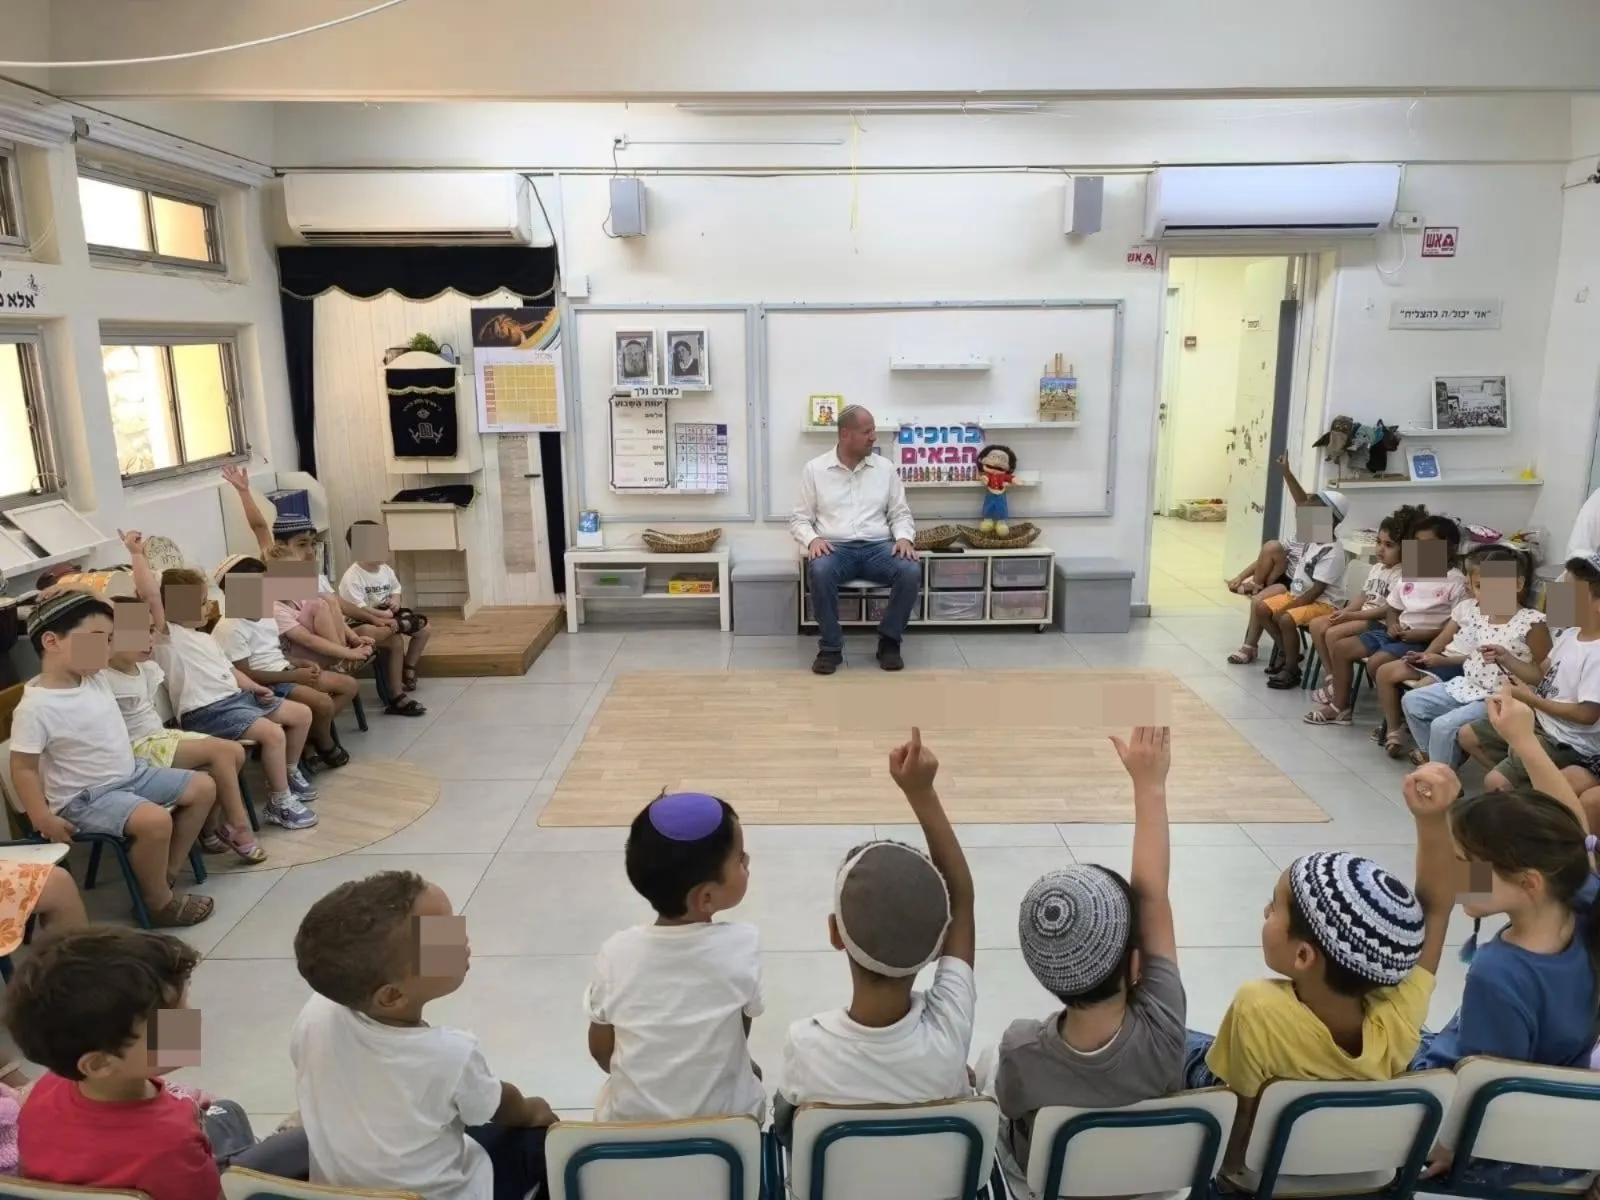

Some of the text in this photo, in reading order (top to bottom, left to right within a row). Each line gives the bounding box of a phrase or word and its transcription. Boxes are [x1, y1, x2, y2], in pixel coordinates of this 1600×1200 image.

[652, 386, 679, 395] לאורם
[898, 426, 981, 444] ברוכים
[901, 446, 978, 464] הבאים
